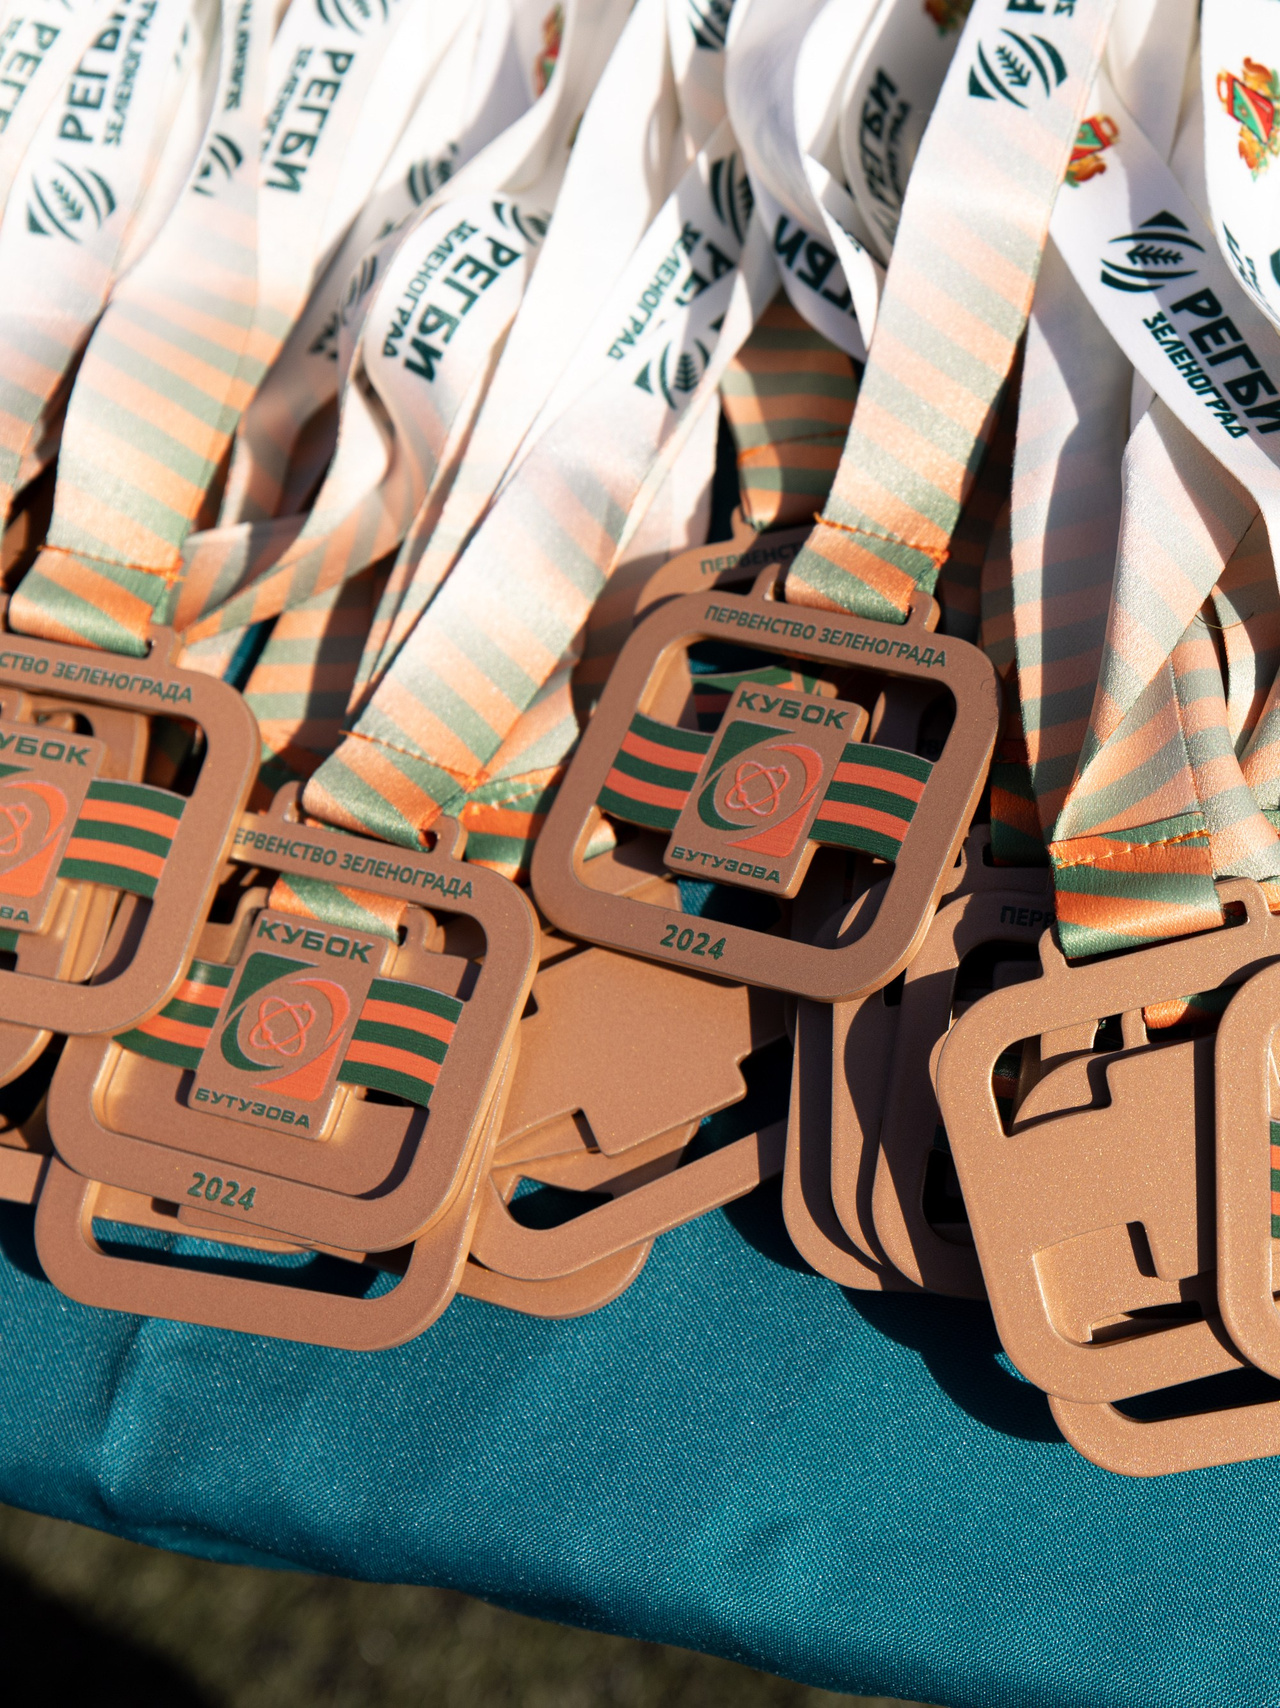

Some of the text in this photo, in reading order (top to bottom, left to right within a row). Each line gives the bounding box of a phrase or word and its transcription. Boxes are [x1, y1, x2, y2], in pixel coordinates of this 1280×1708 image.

[265, 49, 355, 193] РЕГБИ
[382, 219, 480, 359] ЗЕЛЕНОГРАД
[403, 236, 523, 383] РЕГБИ
[1142, 310, 1249, 439] ЗЕЛЕНОГРАД
[704, 605, 946, 668] ПЕРВЕНСТВО ЗЕЛЕНОГРАДА
[52, 661, 193, 703] ЗЕЛЕНОГРАДА
[736, 690, 850, 730] КУБОК
[339, 853, 473, 899] ЗЕЛЕНОГРАДА
[670, 846, 780, 884] БУТУЗОВА
[256, 918, 375, 964] КУБОК
[659, 924, 727, 960] 2024
[194, 1087, 310, 1129] БУТУЗОВА
[186, 1171, 257, 1211] 2024
